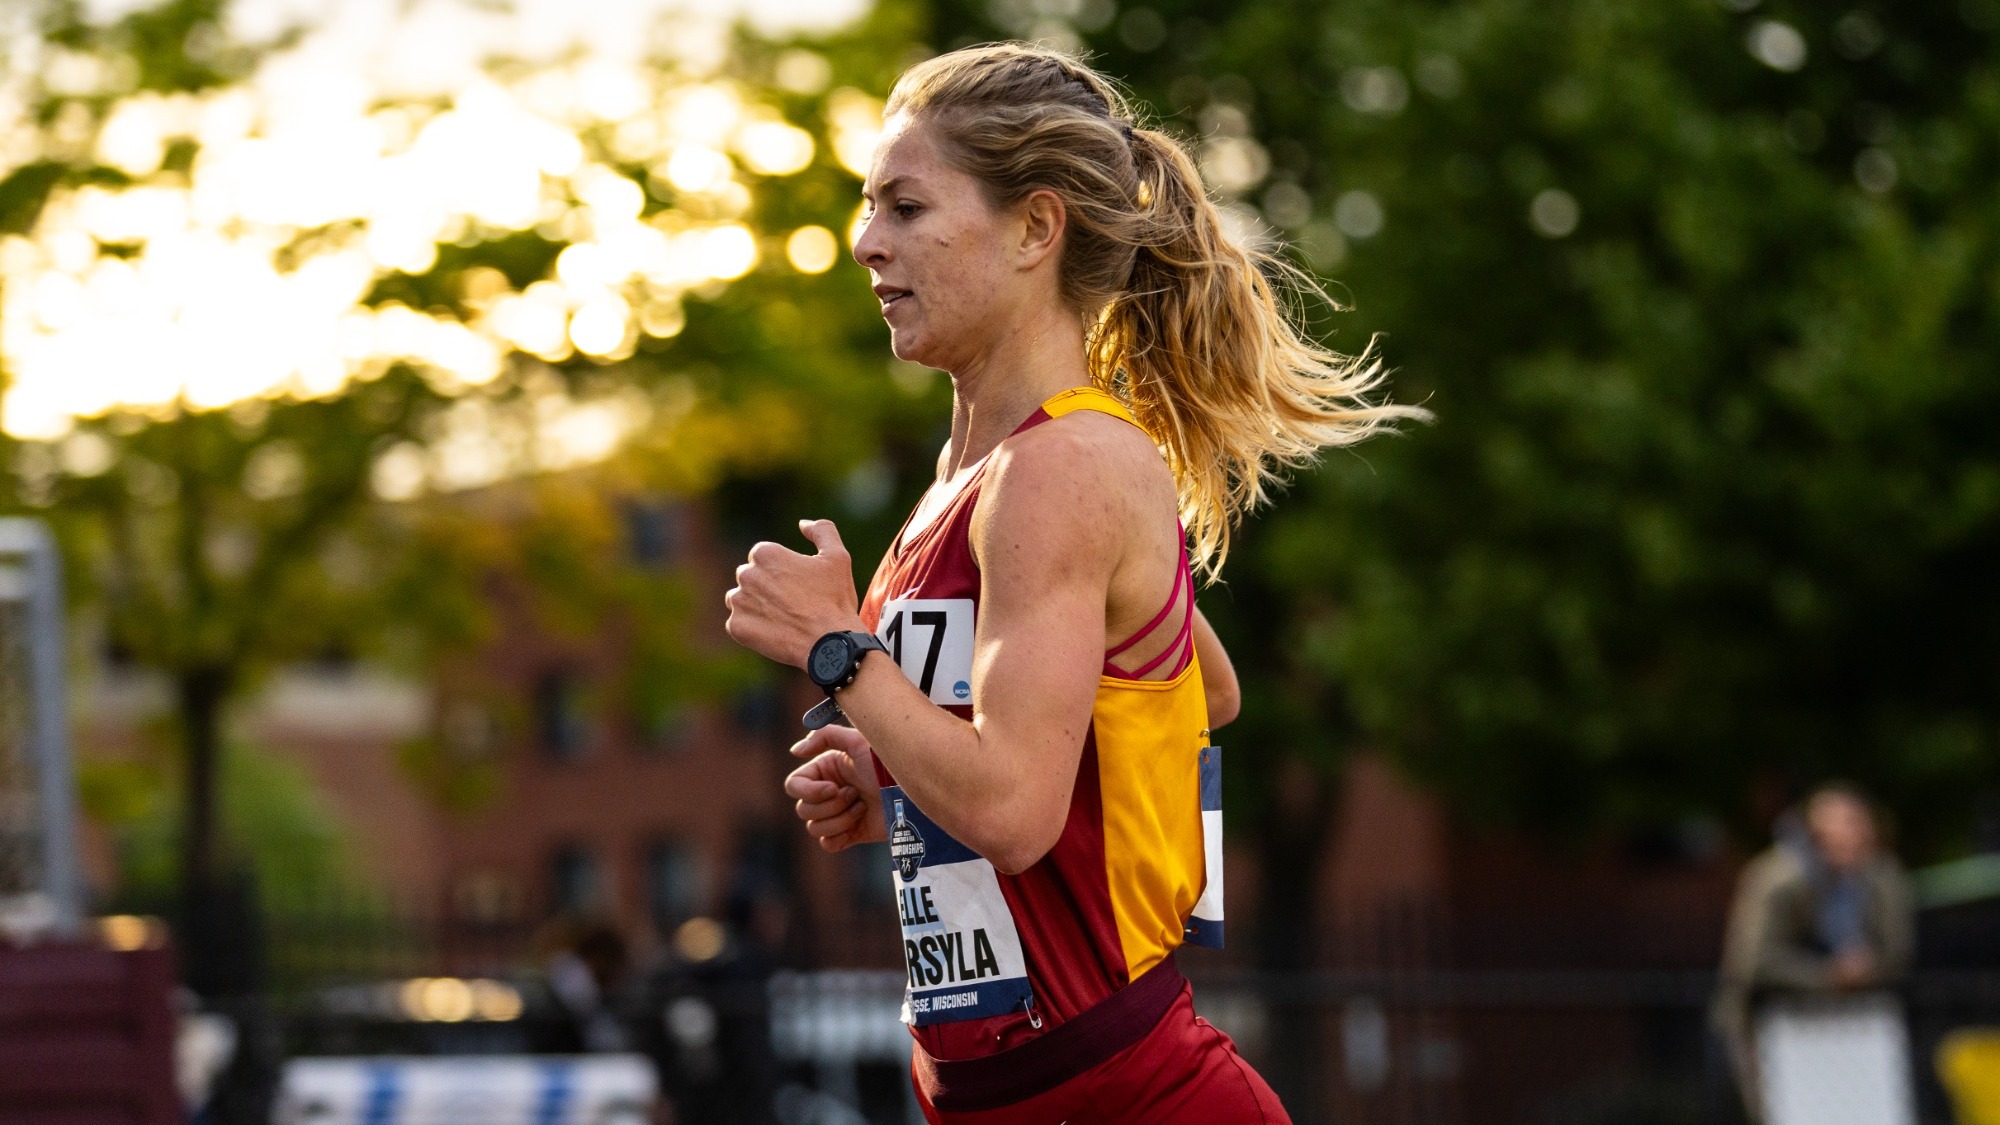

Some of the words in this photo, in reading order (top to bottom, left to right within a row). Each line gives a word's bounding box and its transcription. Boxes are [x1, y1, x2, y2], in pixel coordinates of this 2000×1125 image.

[886, 611, 947, 698] 17
[905, 928, 1000, 987] RSYLA
[914, 997, 931, 1013] SSE,
[932, 991, 978, 1011] WISCONSIN
